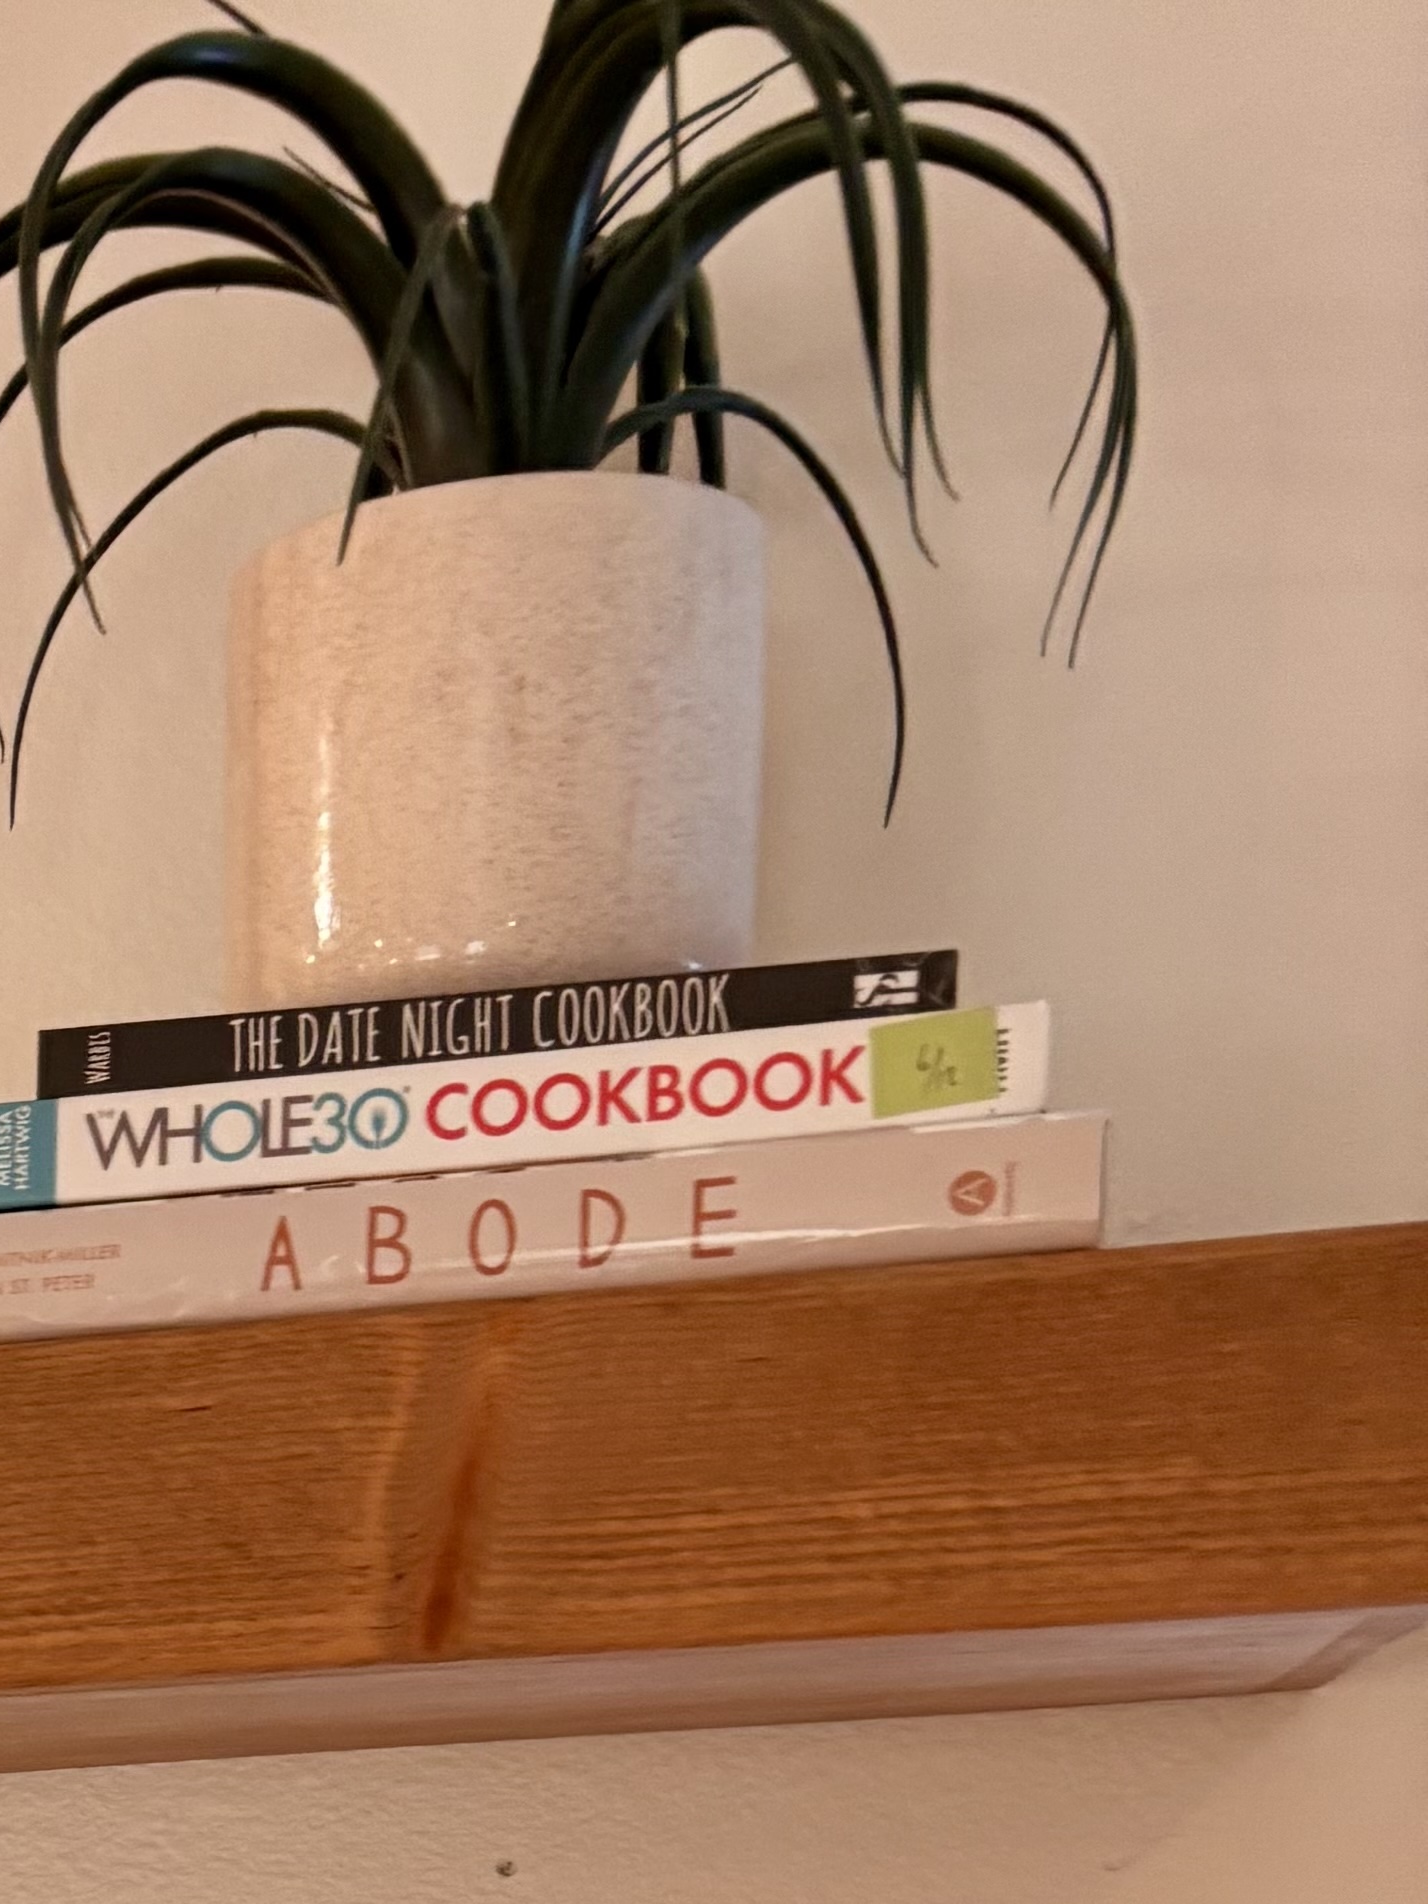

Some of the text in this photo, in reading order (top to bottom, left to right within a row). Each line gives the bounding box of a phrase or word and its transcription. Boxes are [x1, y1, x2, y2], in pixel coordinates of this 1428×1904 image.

[228, 973, 731, 1073] THE DATE NIGHT COOKBOOK
[14, 1104, 32, 1191] HARTWIG
[85, 1087, 410, 1171] WHOLE30
[425, 1045, 866, 1140] COOKBOOK
[259, 1175, 738, 1292] ABODE
